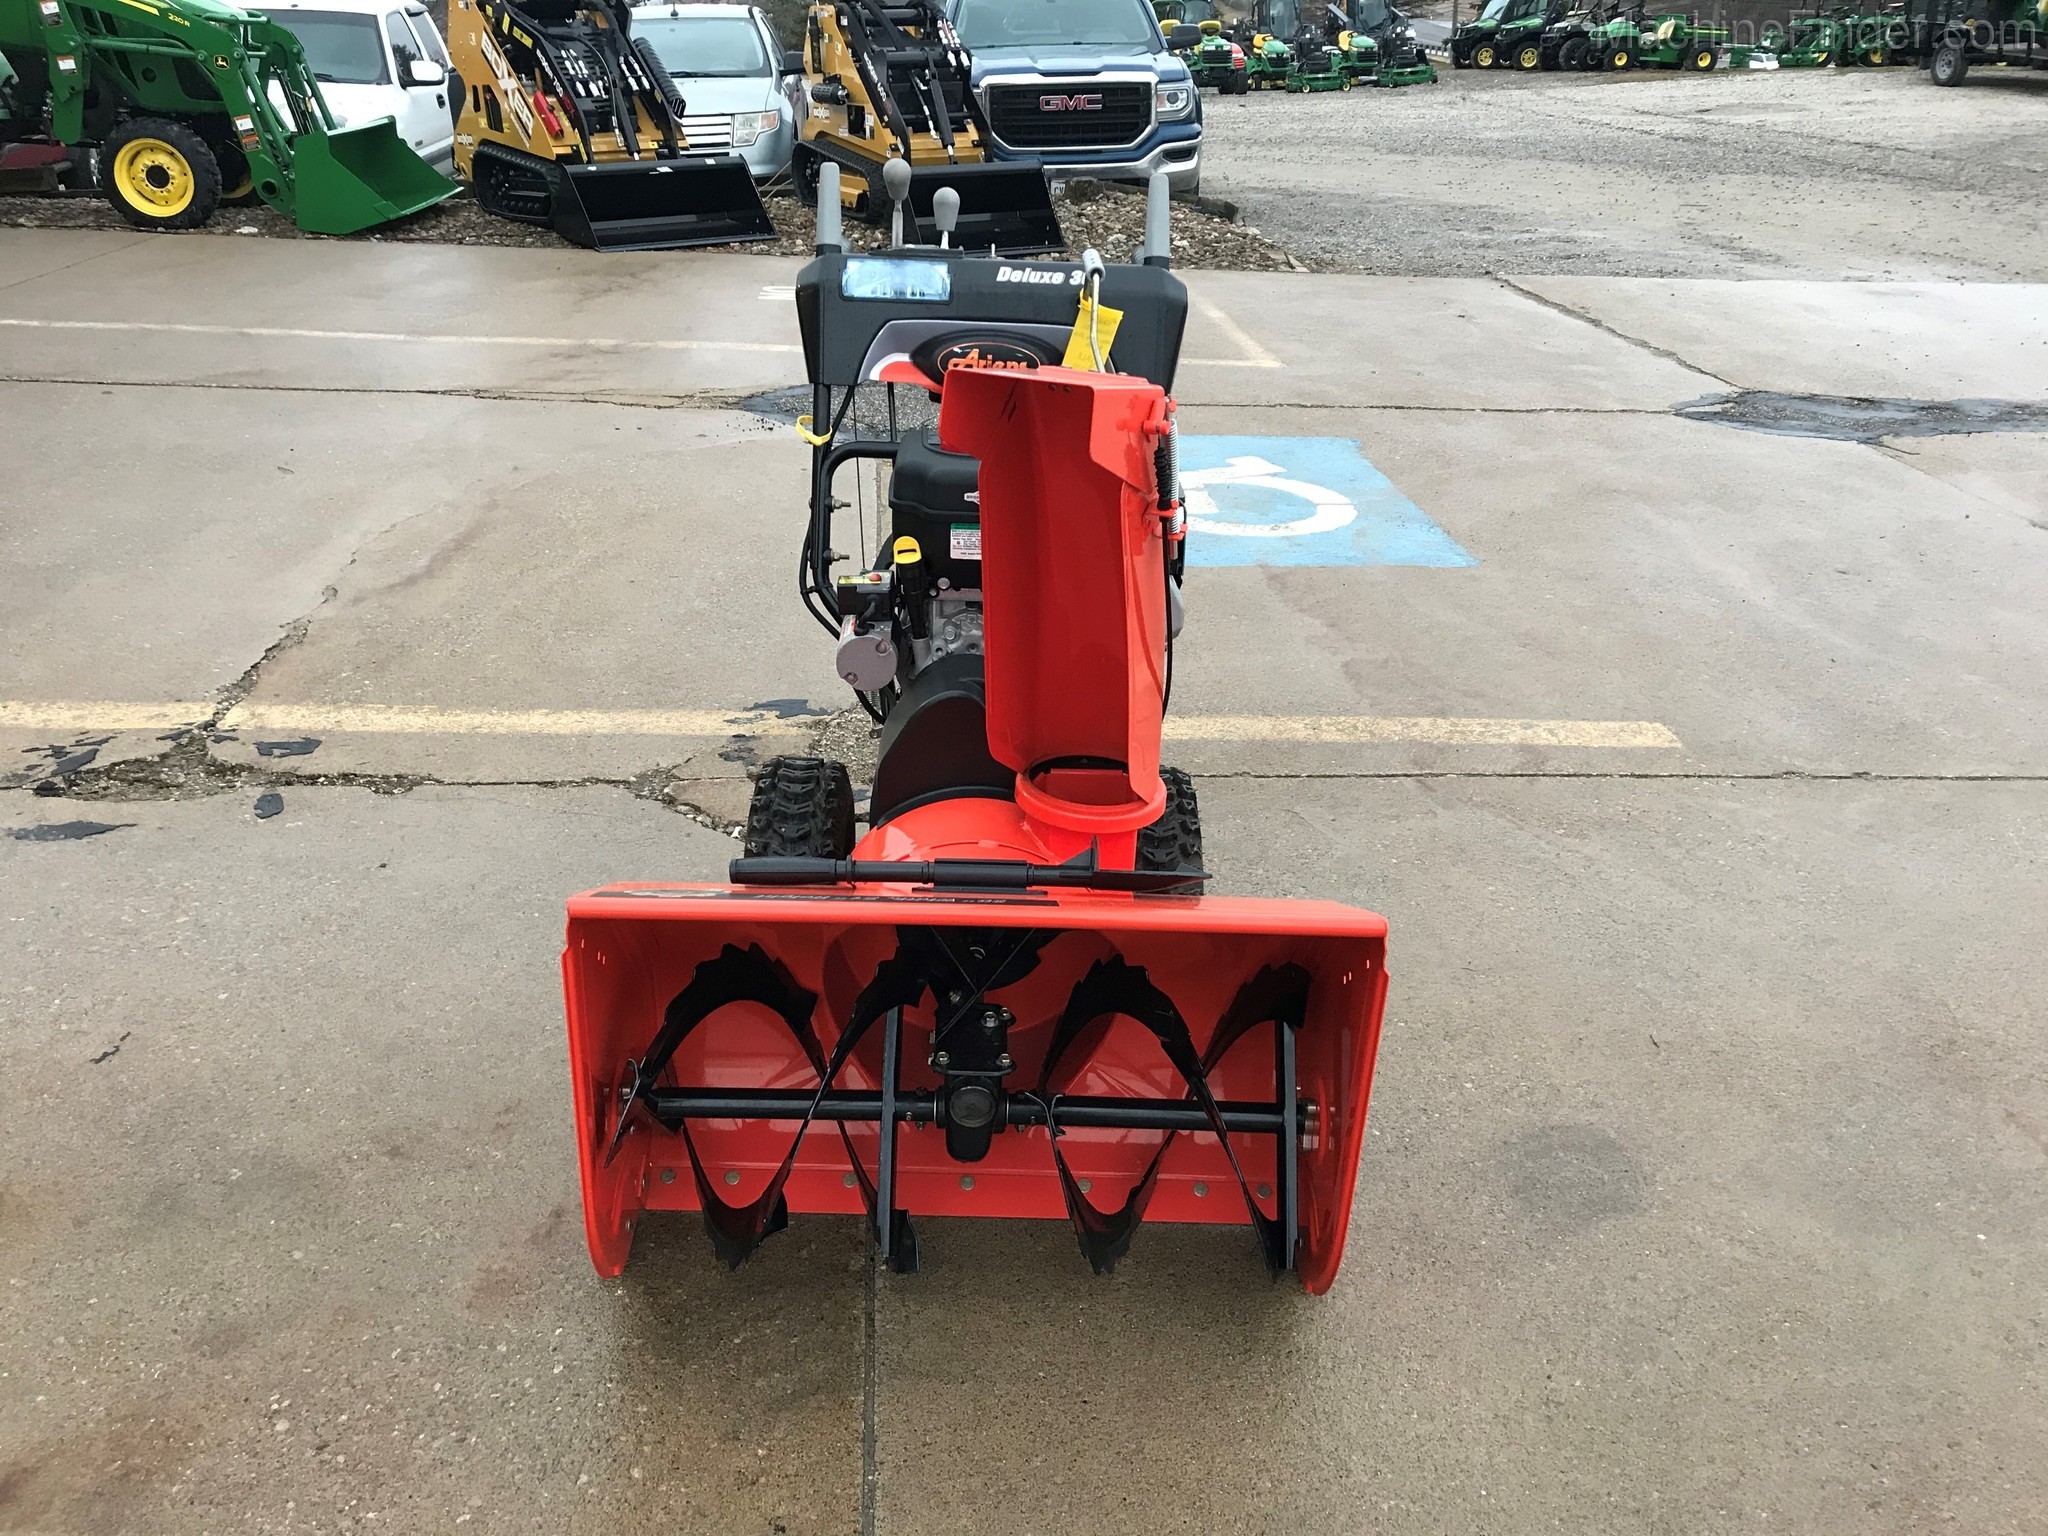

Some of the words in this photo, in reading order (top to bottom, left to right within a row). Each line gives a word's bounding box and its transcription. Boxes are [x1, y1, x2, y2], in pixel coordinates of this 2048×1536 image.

[481, 30, 534, 139] BOXER
[1039, 93, 1103, 112] GMC
[996, 266, 1066, 285] Deluxe
[1069, 270, 1086, 286] 3
